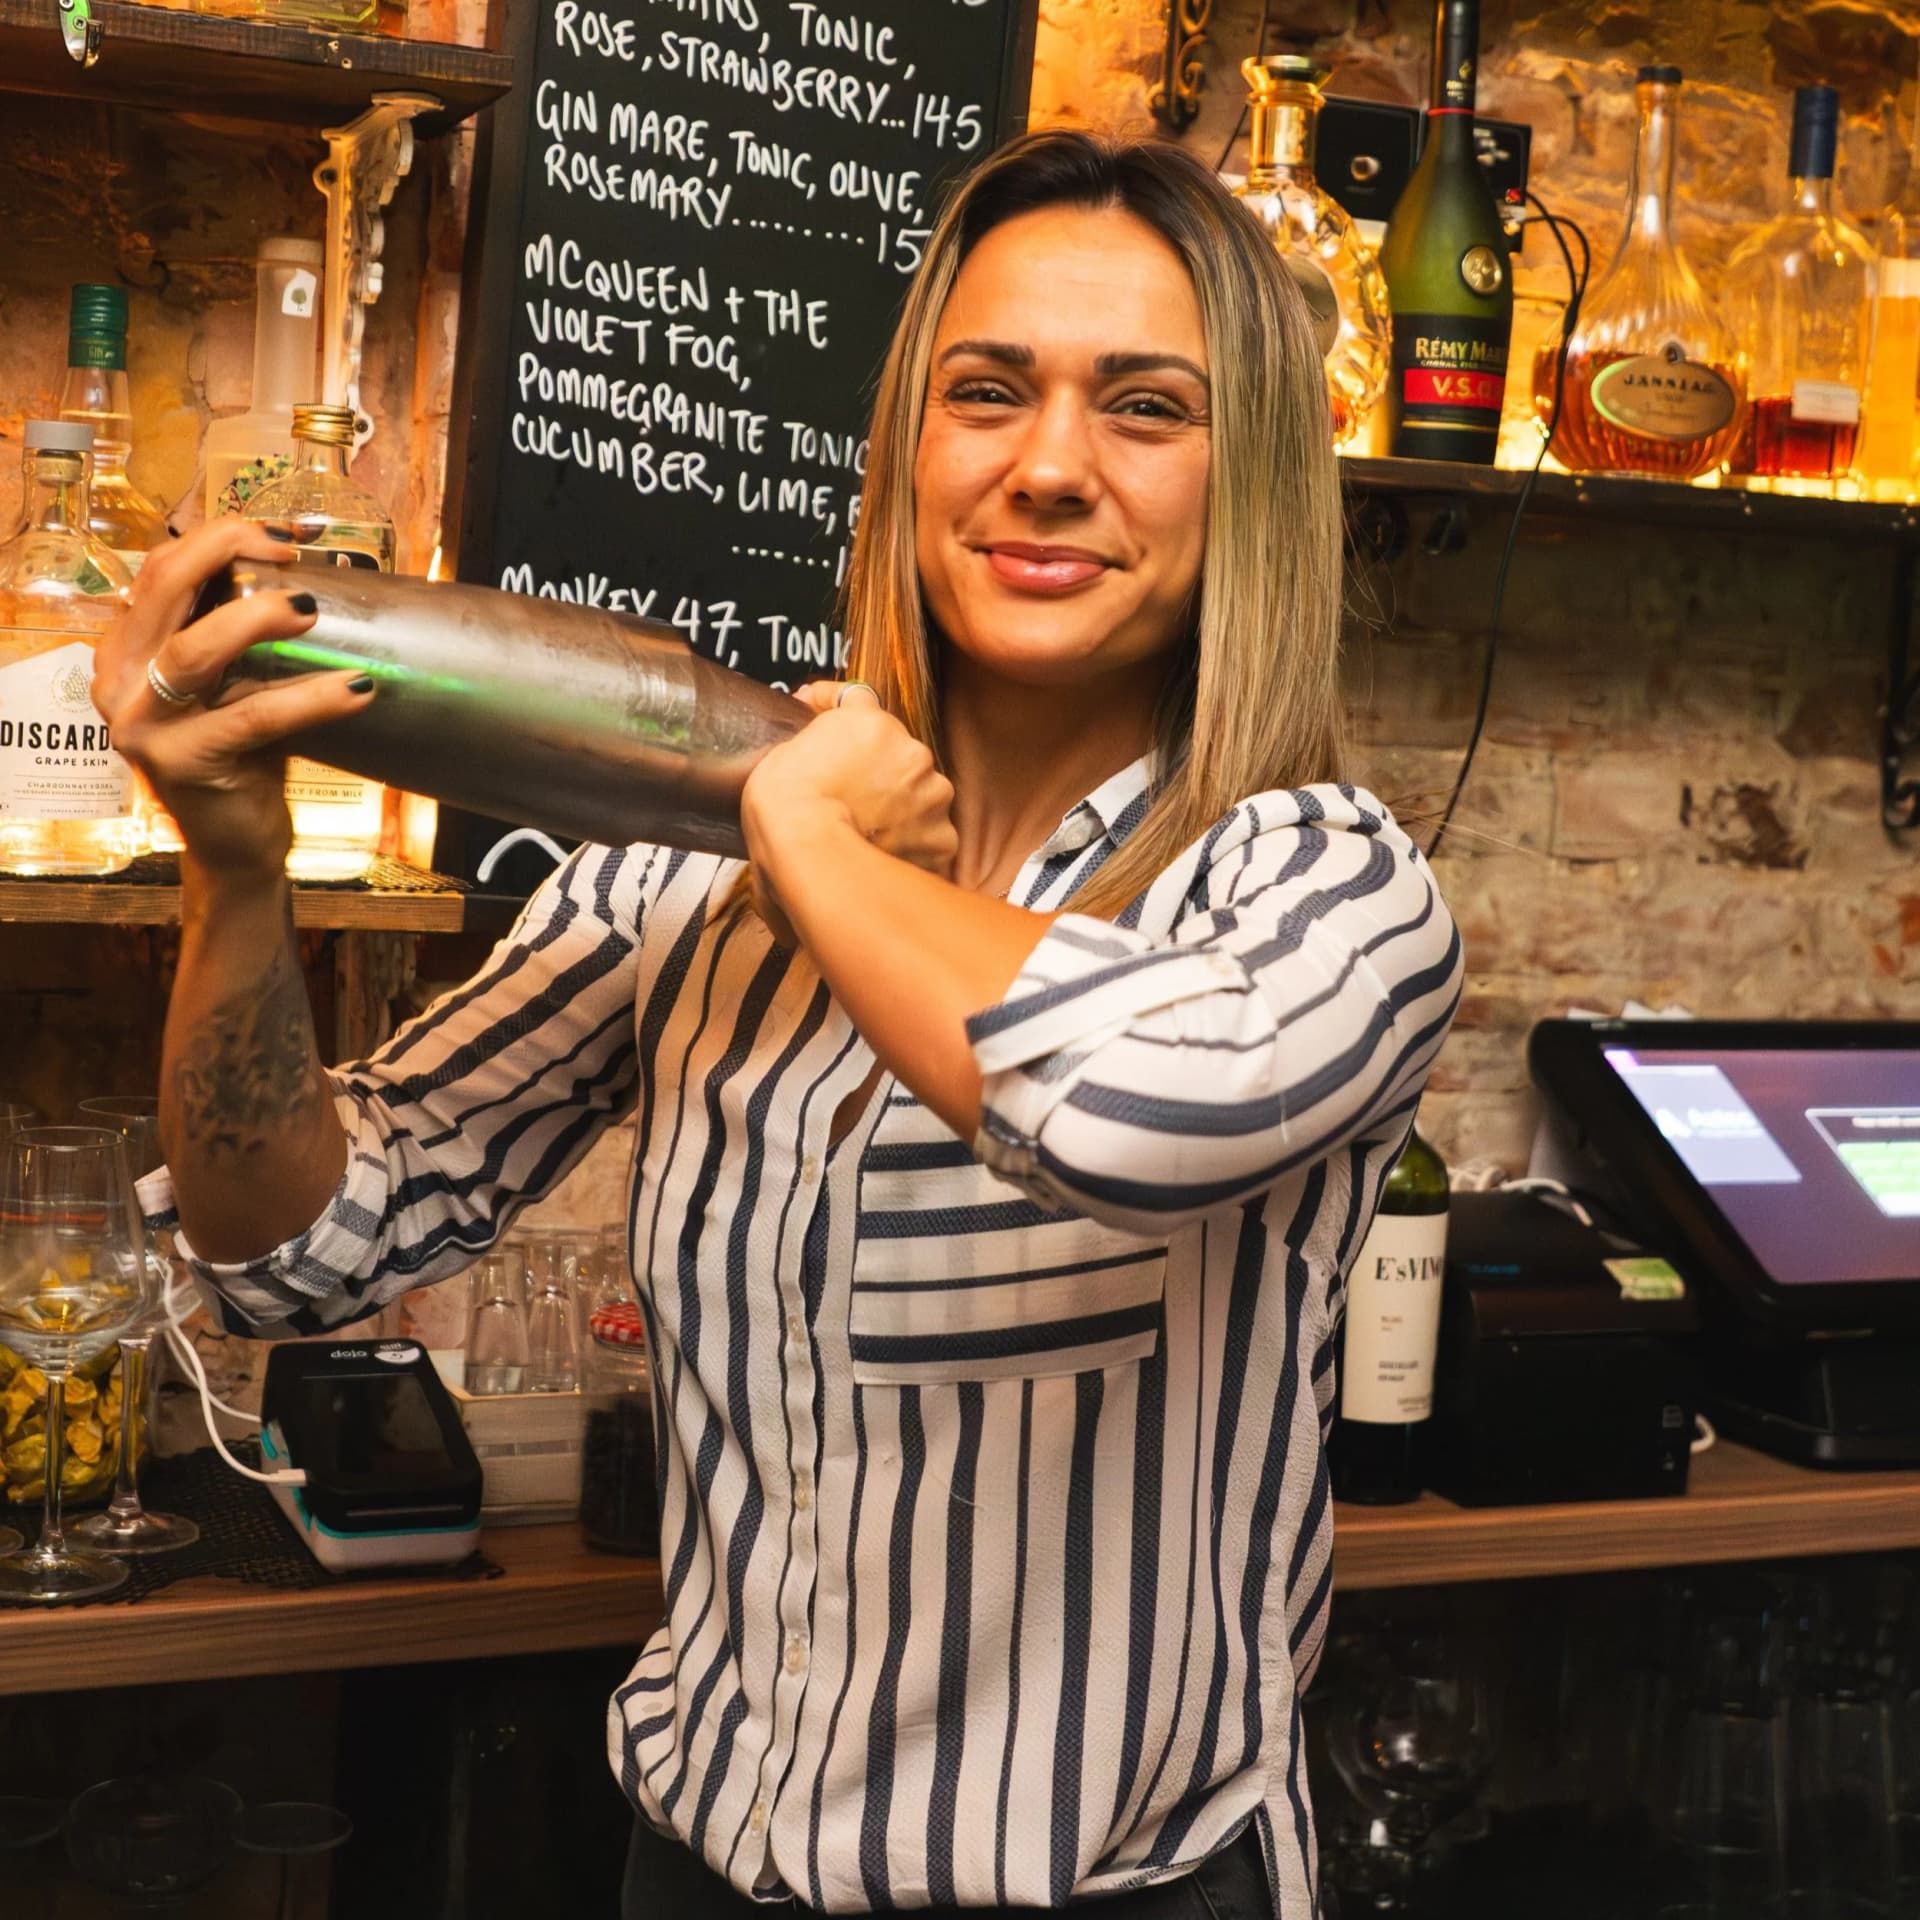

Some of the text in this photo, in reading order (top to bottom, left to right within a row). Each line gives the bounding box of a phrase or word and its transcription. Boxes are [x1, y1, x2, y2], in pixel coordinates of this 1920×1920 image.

[788, 2, 916, 80] TONIC,
[536, 79, 924, 225] GIN MARE, TONIC, OLIVE,
[525, 234, 829, 350] MCQUEEN + THE
[526, 298, 752, 393] VIOLET FOG,
[1415, 335, 1468, 360] RÉMY
[518, 352, 769, 456] POMMEGRANITE
[512, 413, 725, 504] CUCUMBER,
[738, 472, 837, 537] LIME,
[34, 756, 109, 768] GRAPE SKIN
[308, 787, 338, 797] FROM
